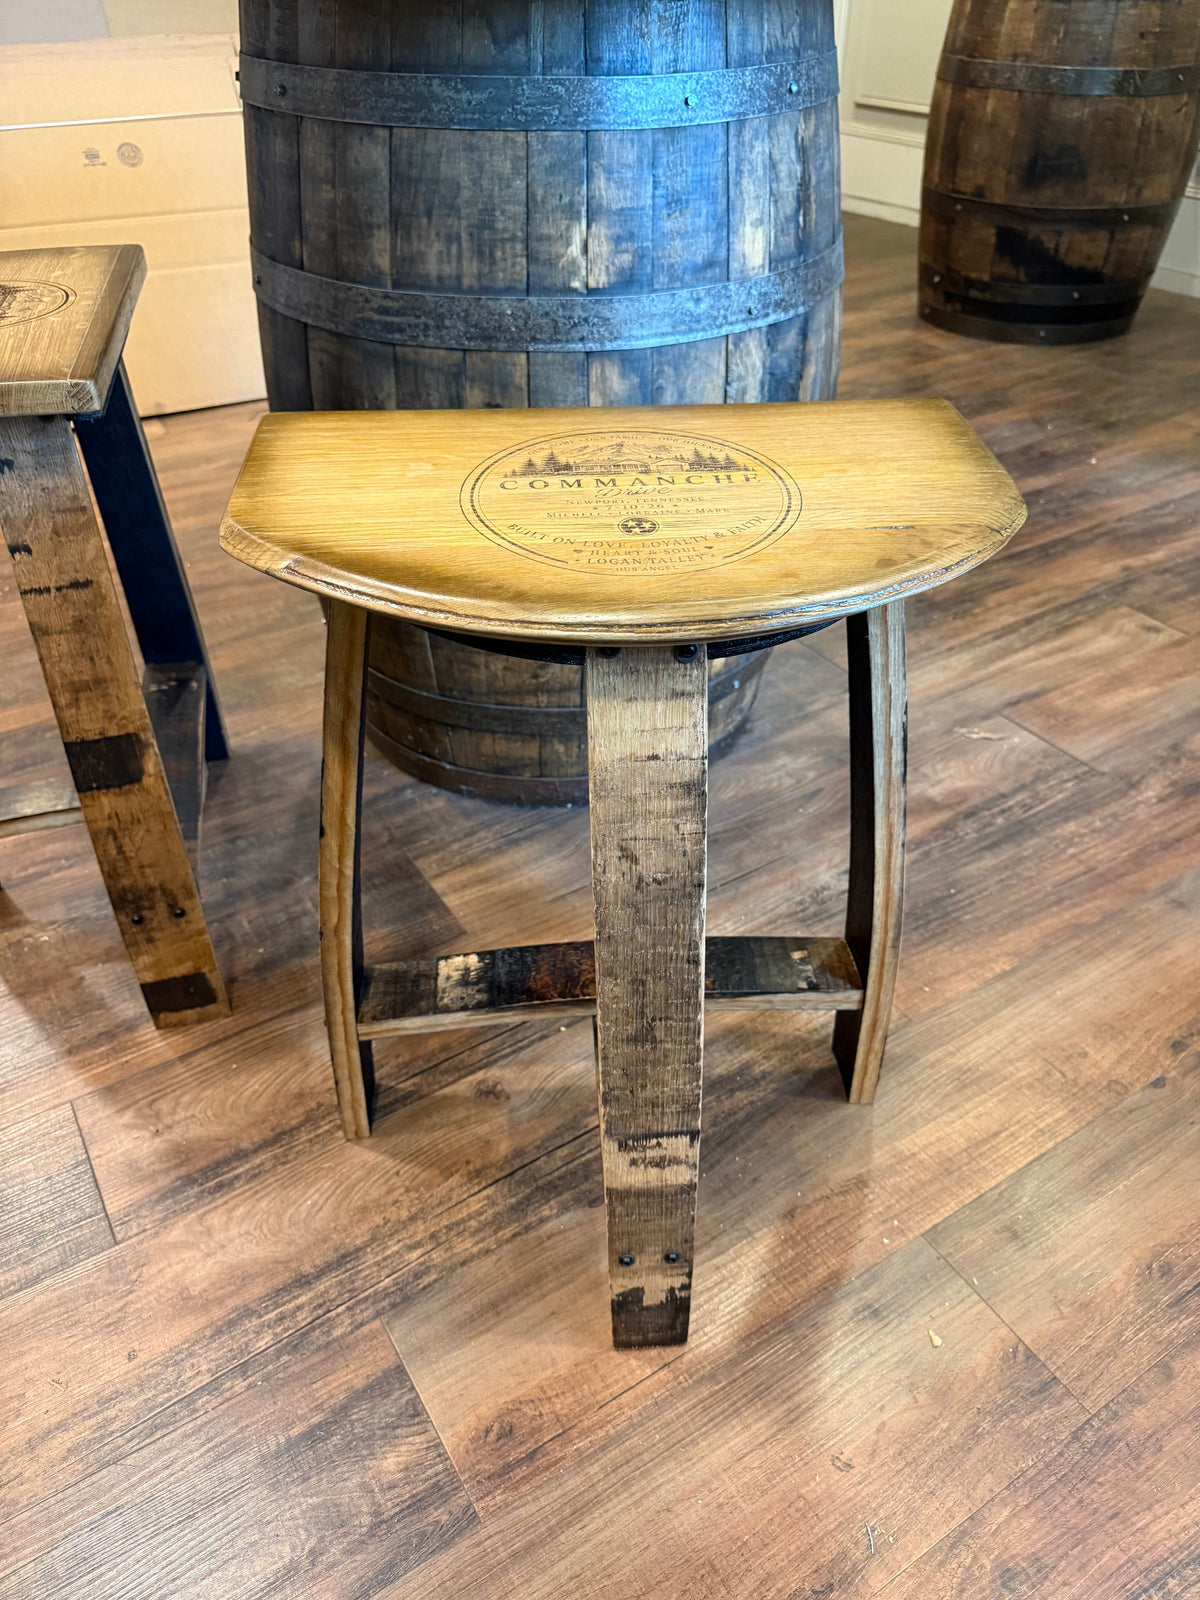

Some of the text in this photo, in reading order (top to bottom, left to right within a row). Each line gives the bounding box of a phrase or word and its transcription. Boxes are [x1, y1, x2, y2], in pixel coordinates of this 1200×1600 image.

[499, 474, 760, 490] COMMANCHE
[594, 487, 672, 498] Drive
[507, 523, 550, 540] BUILT
[553, 537, 577, 545] ON
[583, 540, 633, 549] LOVE,
[641, 535, 709, 548] LOYALTY
[728, 515, 767, 535] FAITH
[663, 546, 700, 554] SOUL
